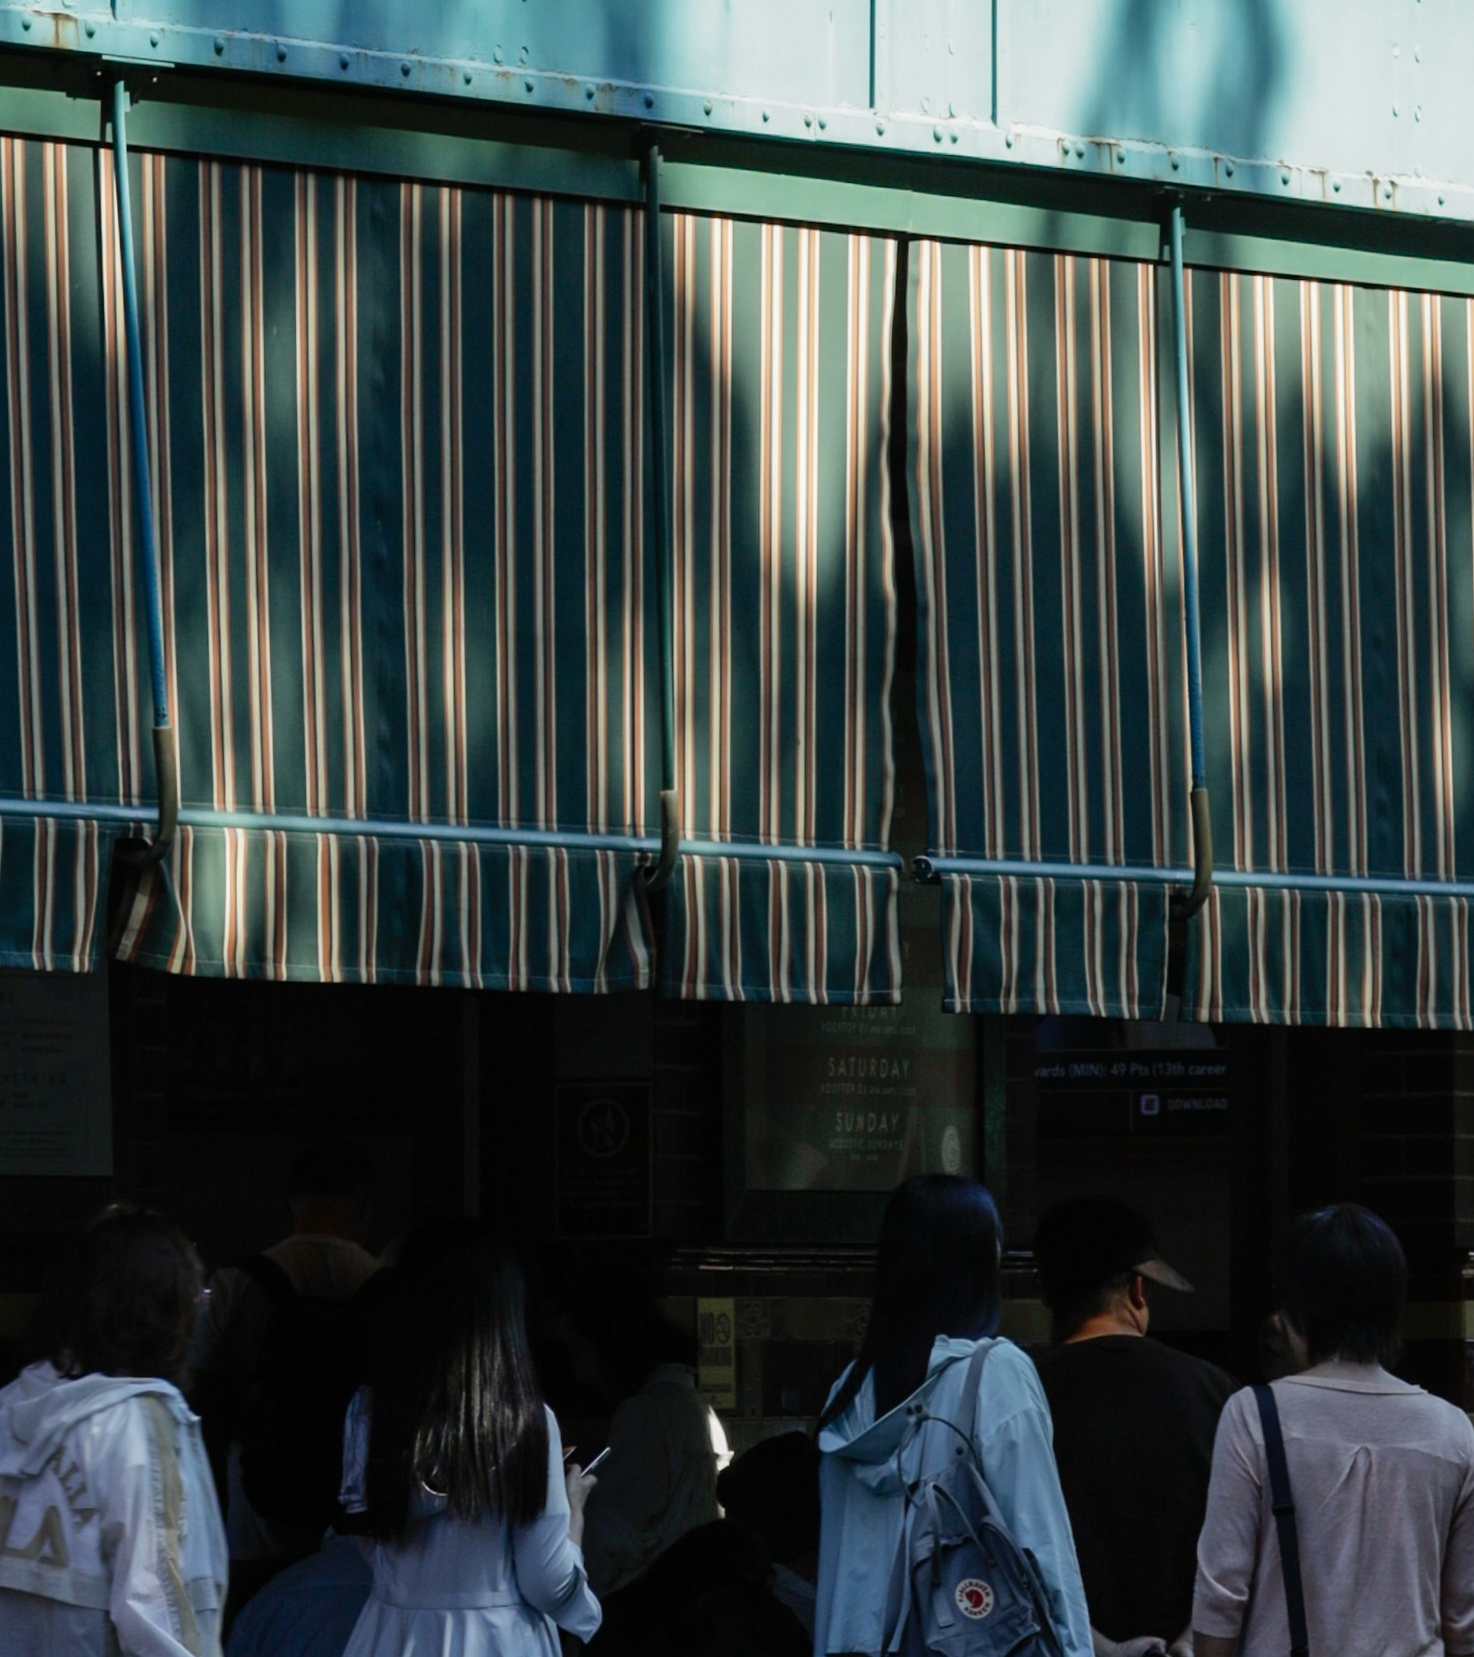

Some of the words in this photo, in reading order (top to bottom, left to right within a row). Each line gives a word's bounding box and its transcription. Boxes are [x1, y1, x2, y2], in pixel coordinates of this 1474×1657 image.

[828, 1056, 911, 1079] SATURDAY
[1110, 1062, 1127, 1076] 49
[1129, 1062, 1151, 1077] Pts
[1188, 1063, 1228, 1076] career
[1166, 1096, 1228, 1111] DOWNLOAD
[835, 1111, 901, 1133] SUNDAY
